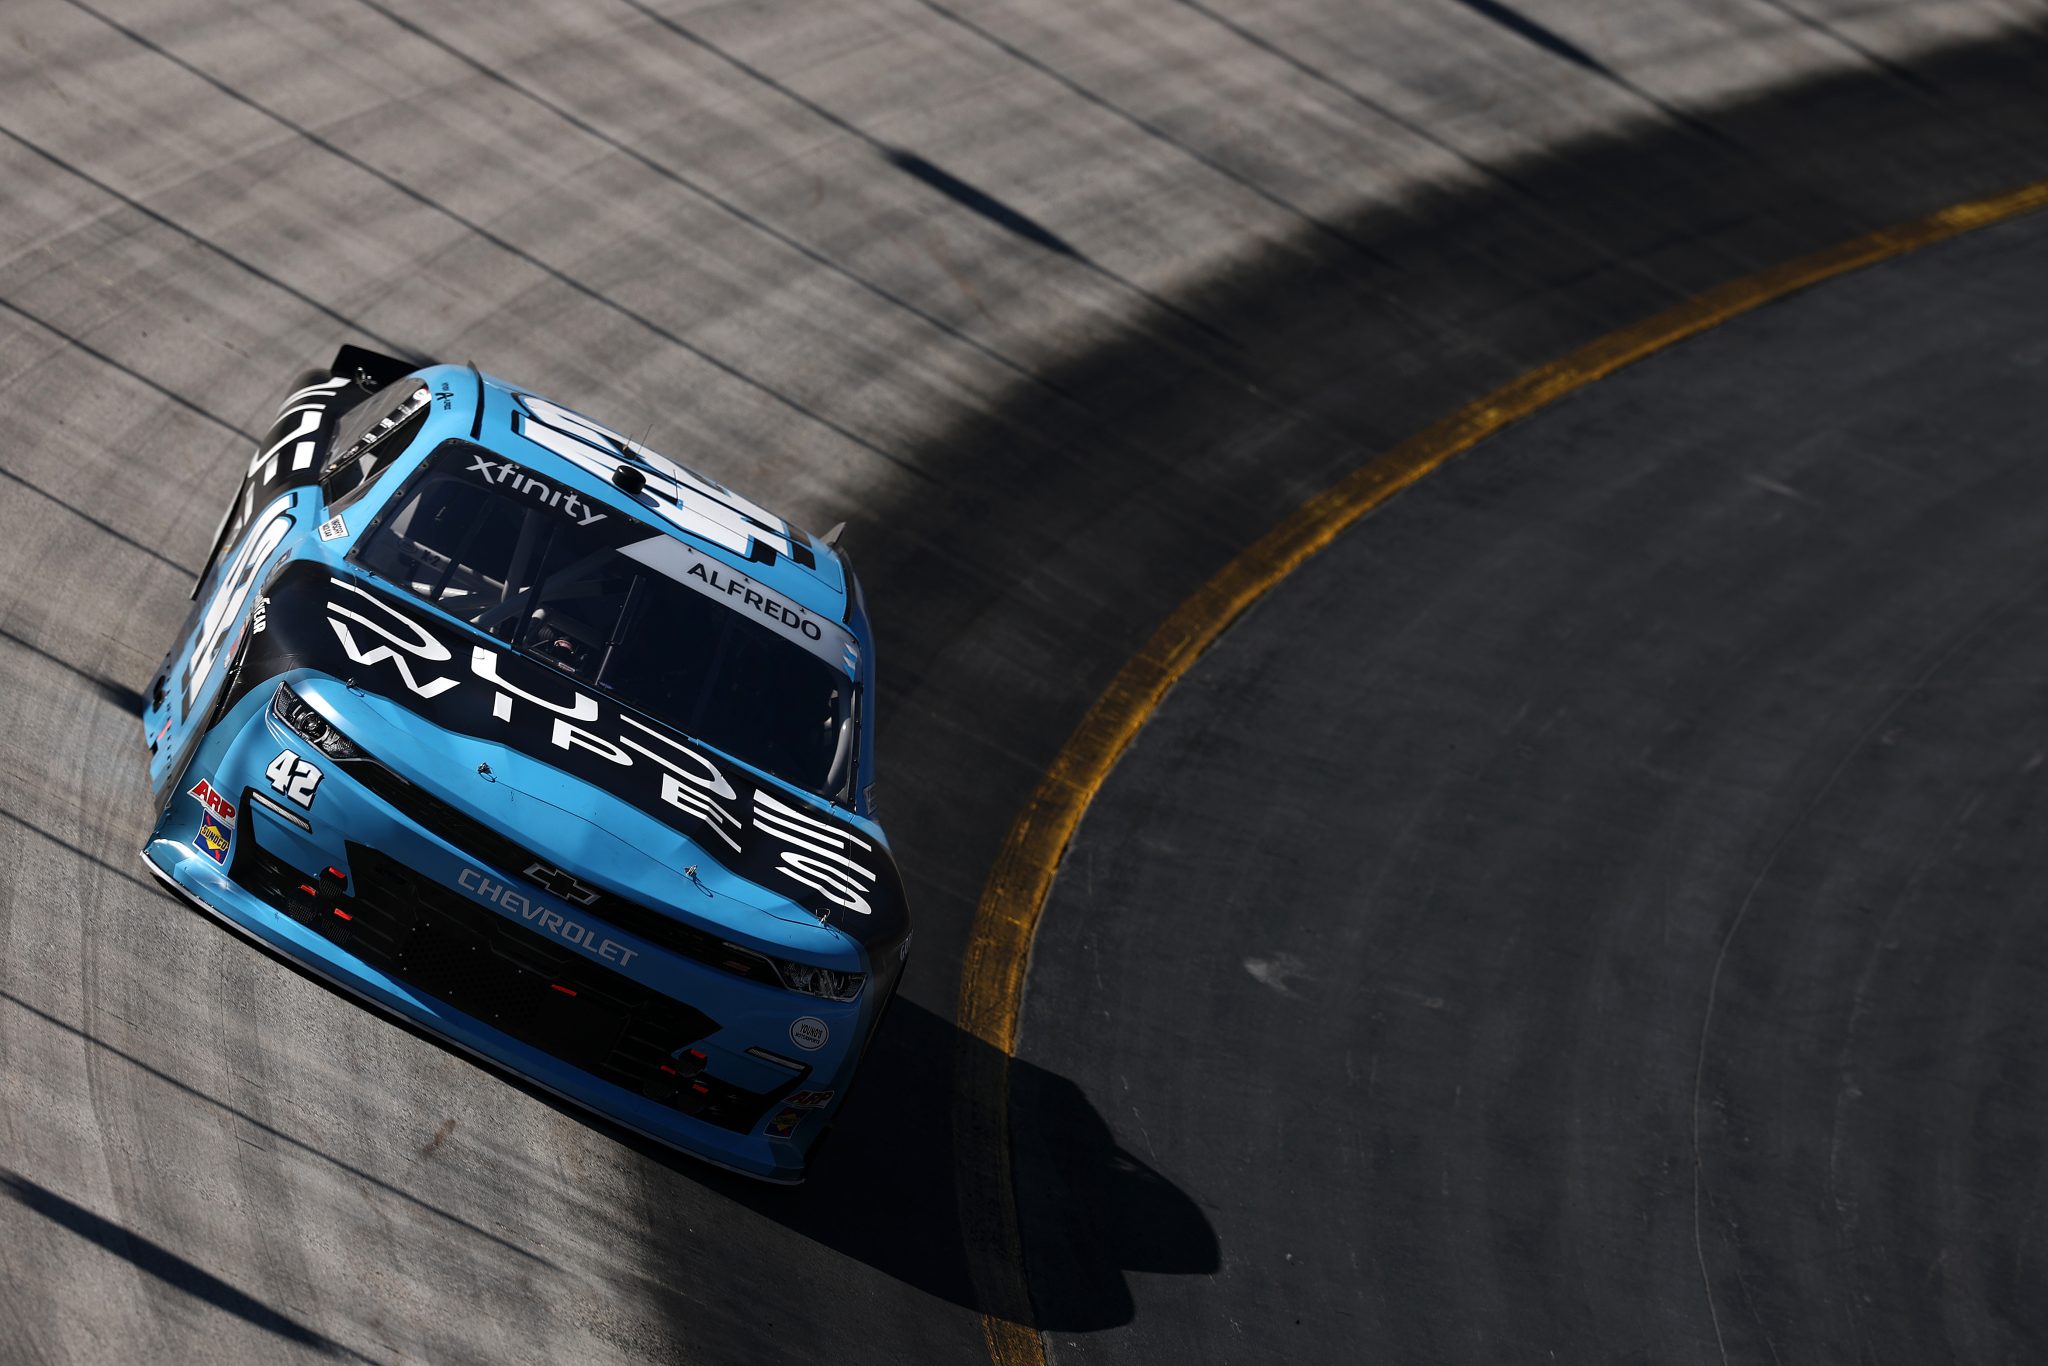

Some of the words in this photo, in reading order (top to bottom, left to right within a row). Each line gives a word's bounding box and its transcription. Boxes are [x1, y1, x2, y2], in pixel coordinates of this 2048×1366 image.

[466, 454, 608, 526] xfinity
[688, 562, 821, 641] ALFREDO
[190, 780, 236, 819] ARP
[265, 749, 325, 810] 42
[326, 616, 872, 914] WIPES
[202, 826, 229, 850] SUNOCO
[457, 868, 639, 967] CHEVROLET
